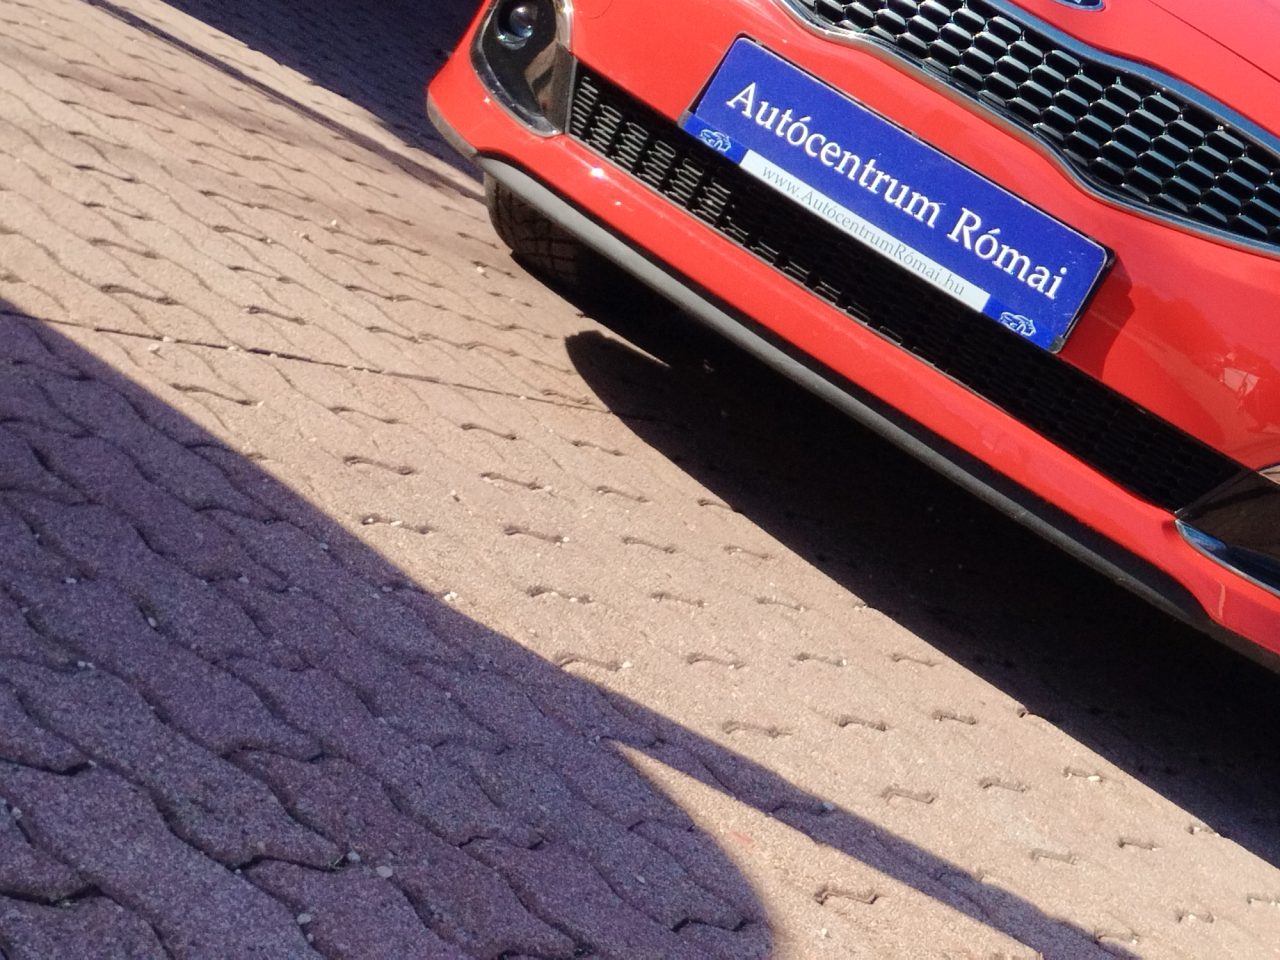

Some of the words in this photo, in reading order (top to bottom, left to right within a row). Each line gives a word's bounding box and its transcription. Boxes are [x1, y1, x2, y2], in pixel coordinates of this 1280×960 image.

[726, 81, 942, 228] Autócentrum
[947, 206, 1068, 301] Római
[762, 164, 966, 297] www.AutócentrumRómai.hu
